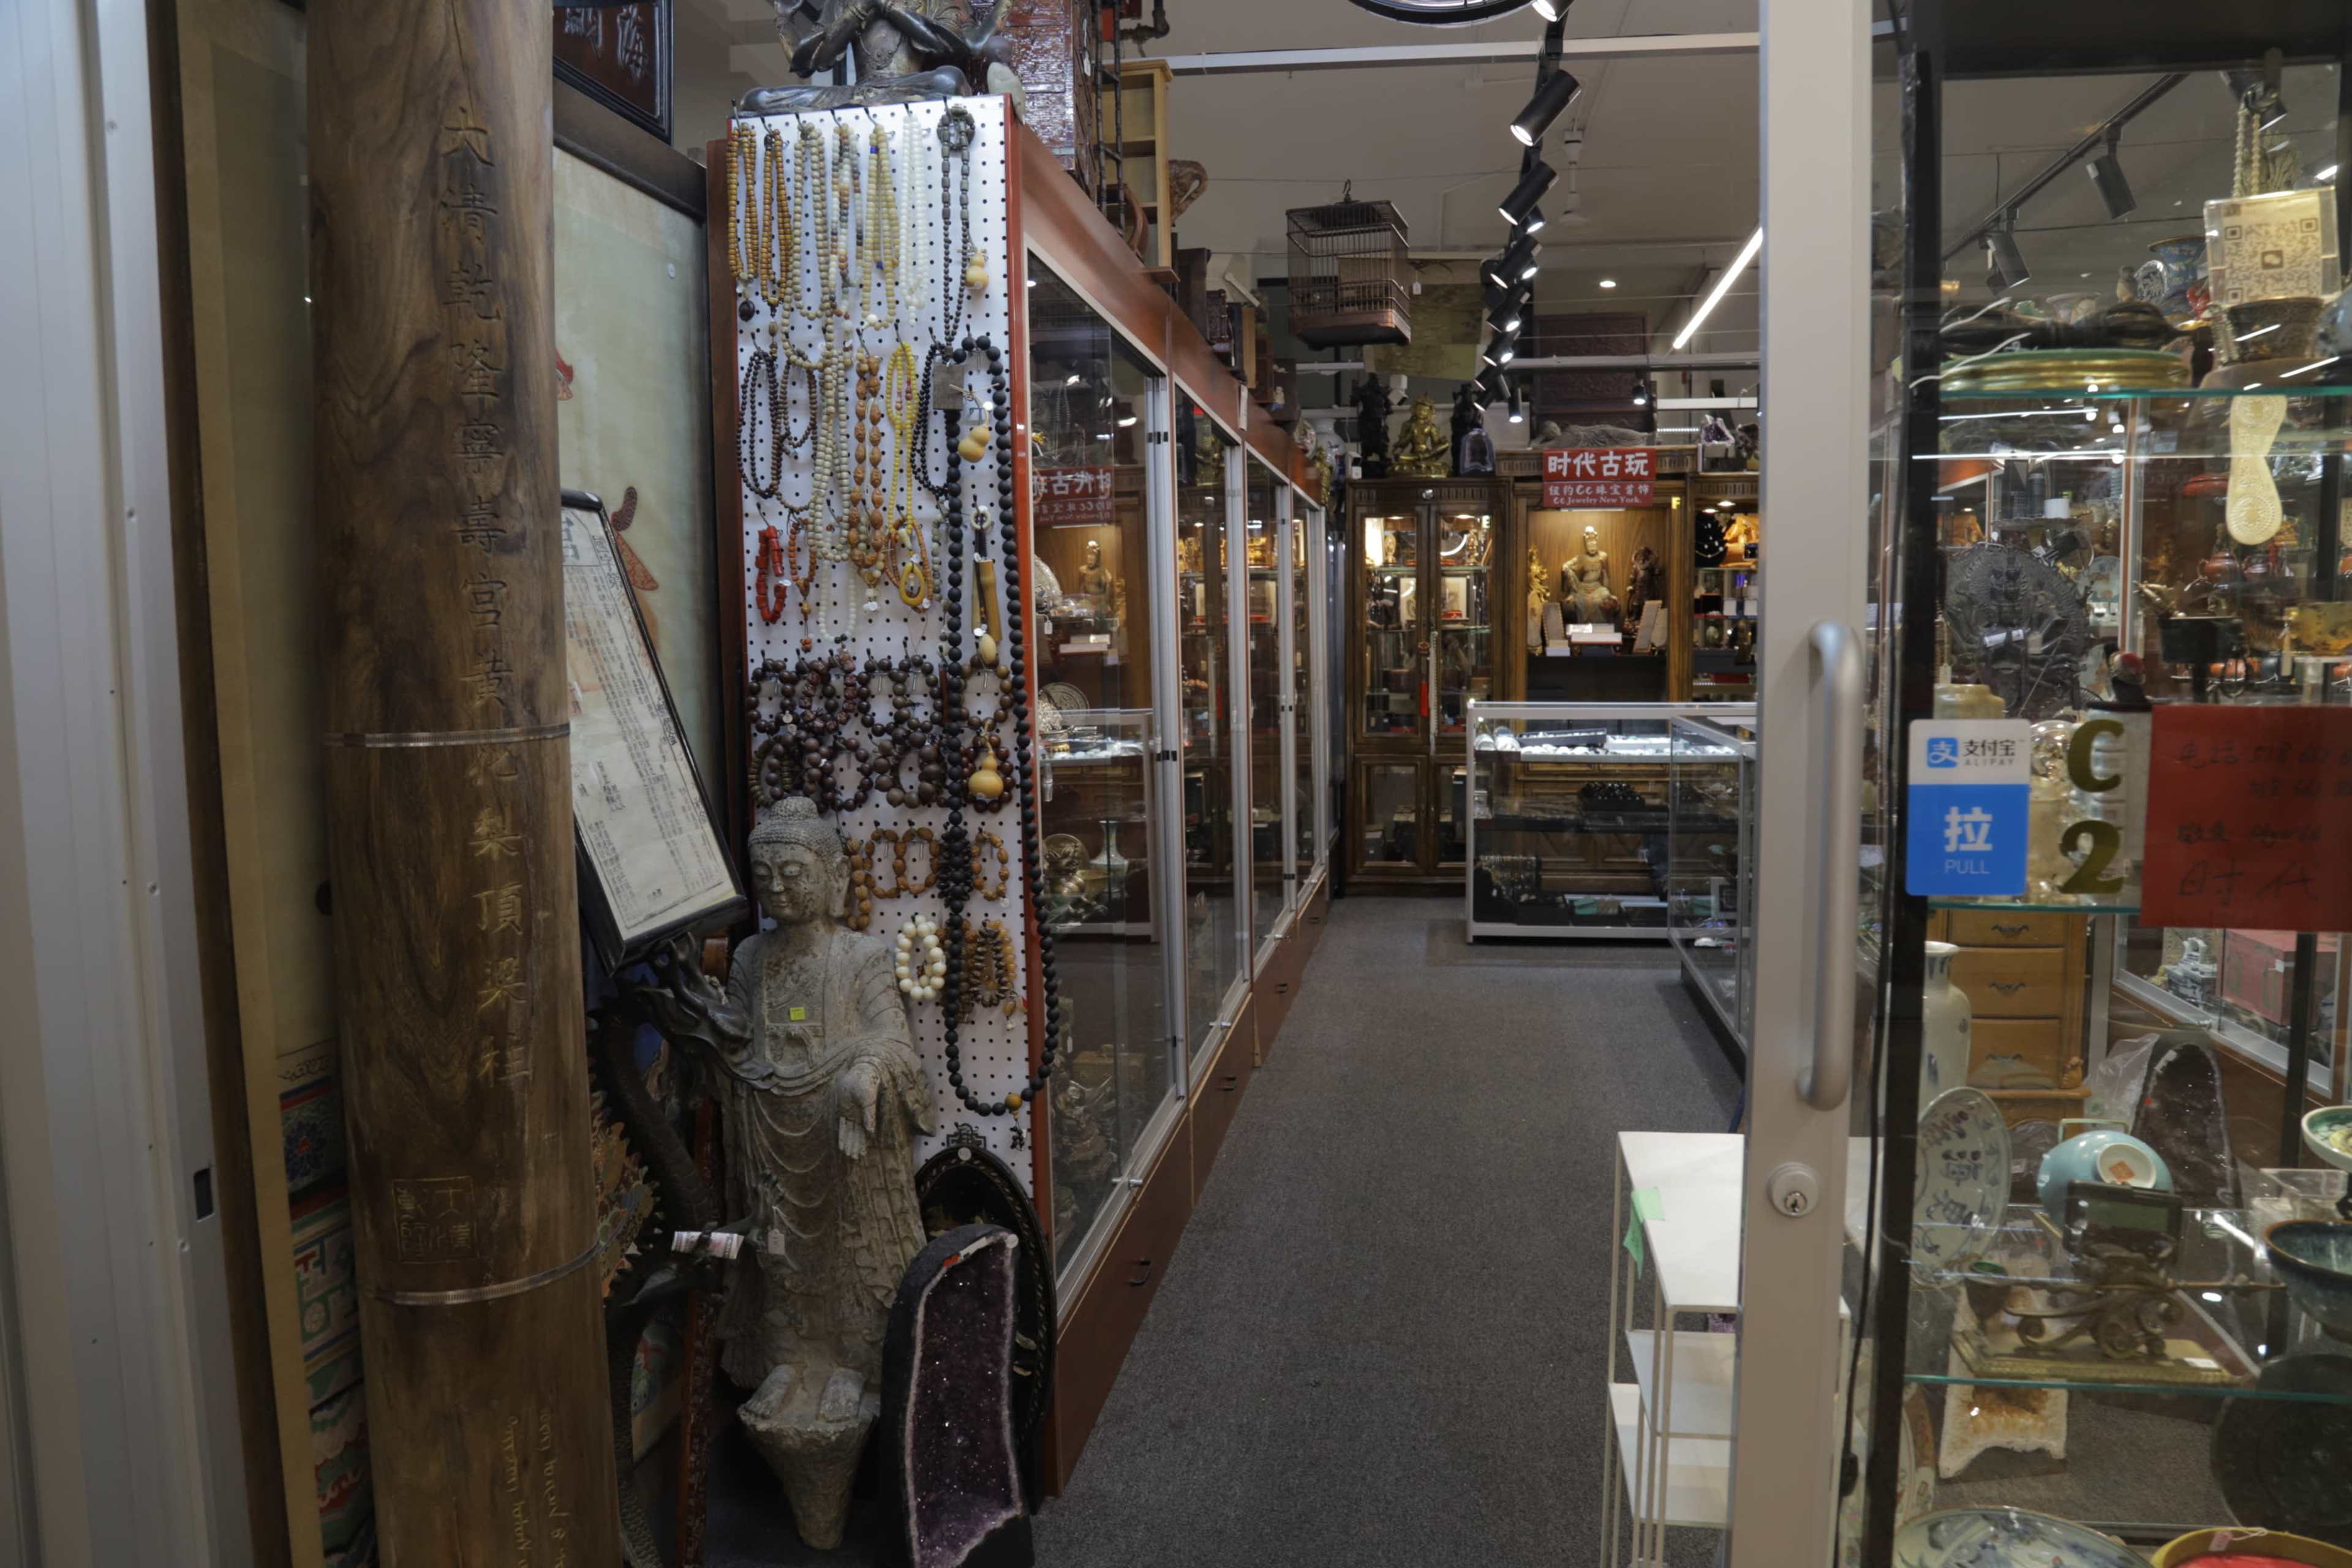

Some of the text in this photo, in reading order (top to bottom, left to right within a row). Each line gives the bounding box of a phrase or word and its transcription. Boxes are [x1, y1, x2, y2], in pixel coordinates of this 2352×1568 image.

[1548, 450, 1649, 478] 时代古玩
[1567, 496, 1597, 505] Jewelry
[1672, 497, 1681, 510] F
[1963, 739, 2015, 756] 支付宝
[2068, 720, 2124, 792] C
[1944, 806, 1993, 852] 拉
[1944, 860, 1989, 875] PULL
[2059, 820, 2124, 894] 2
